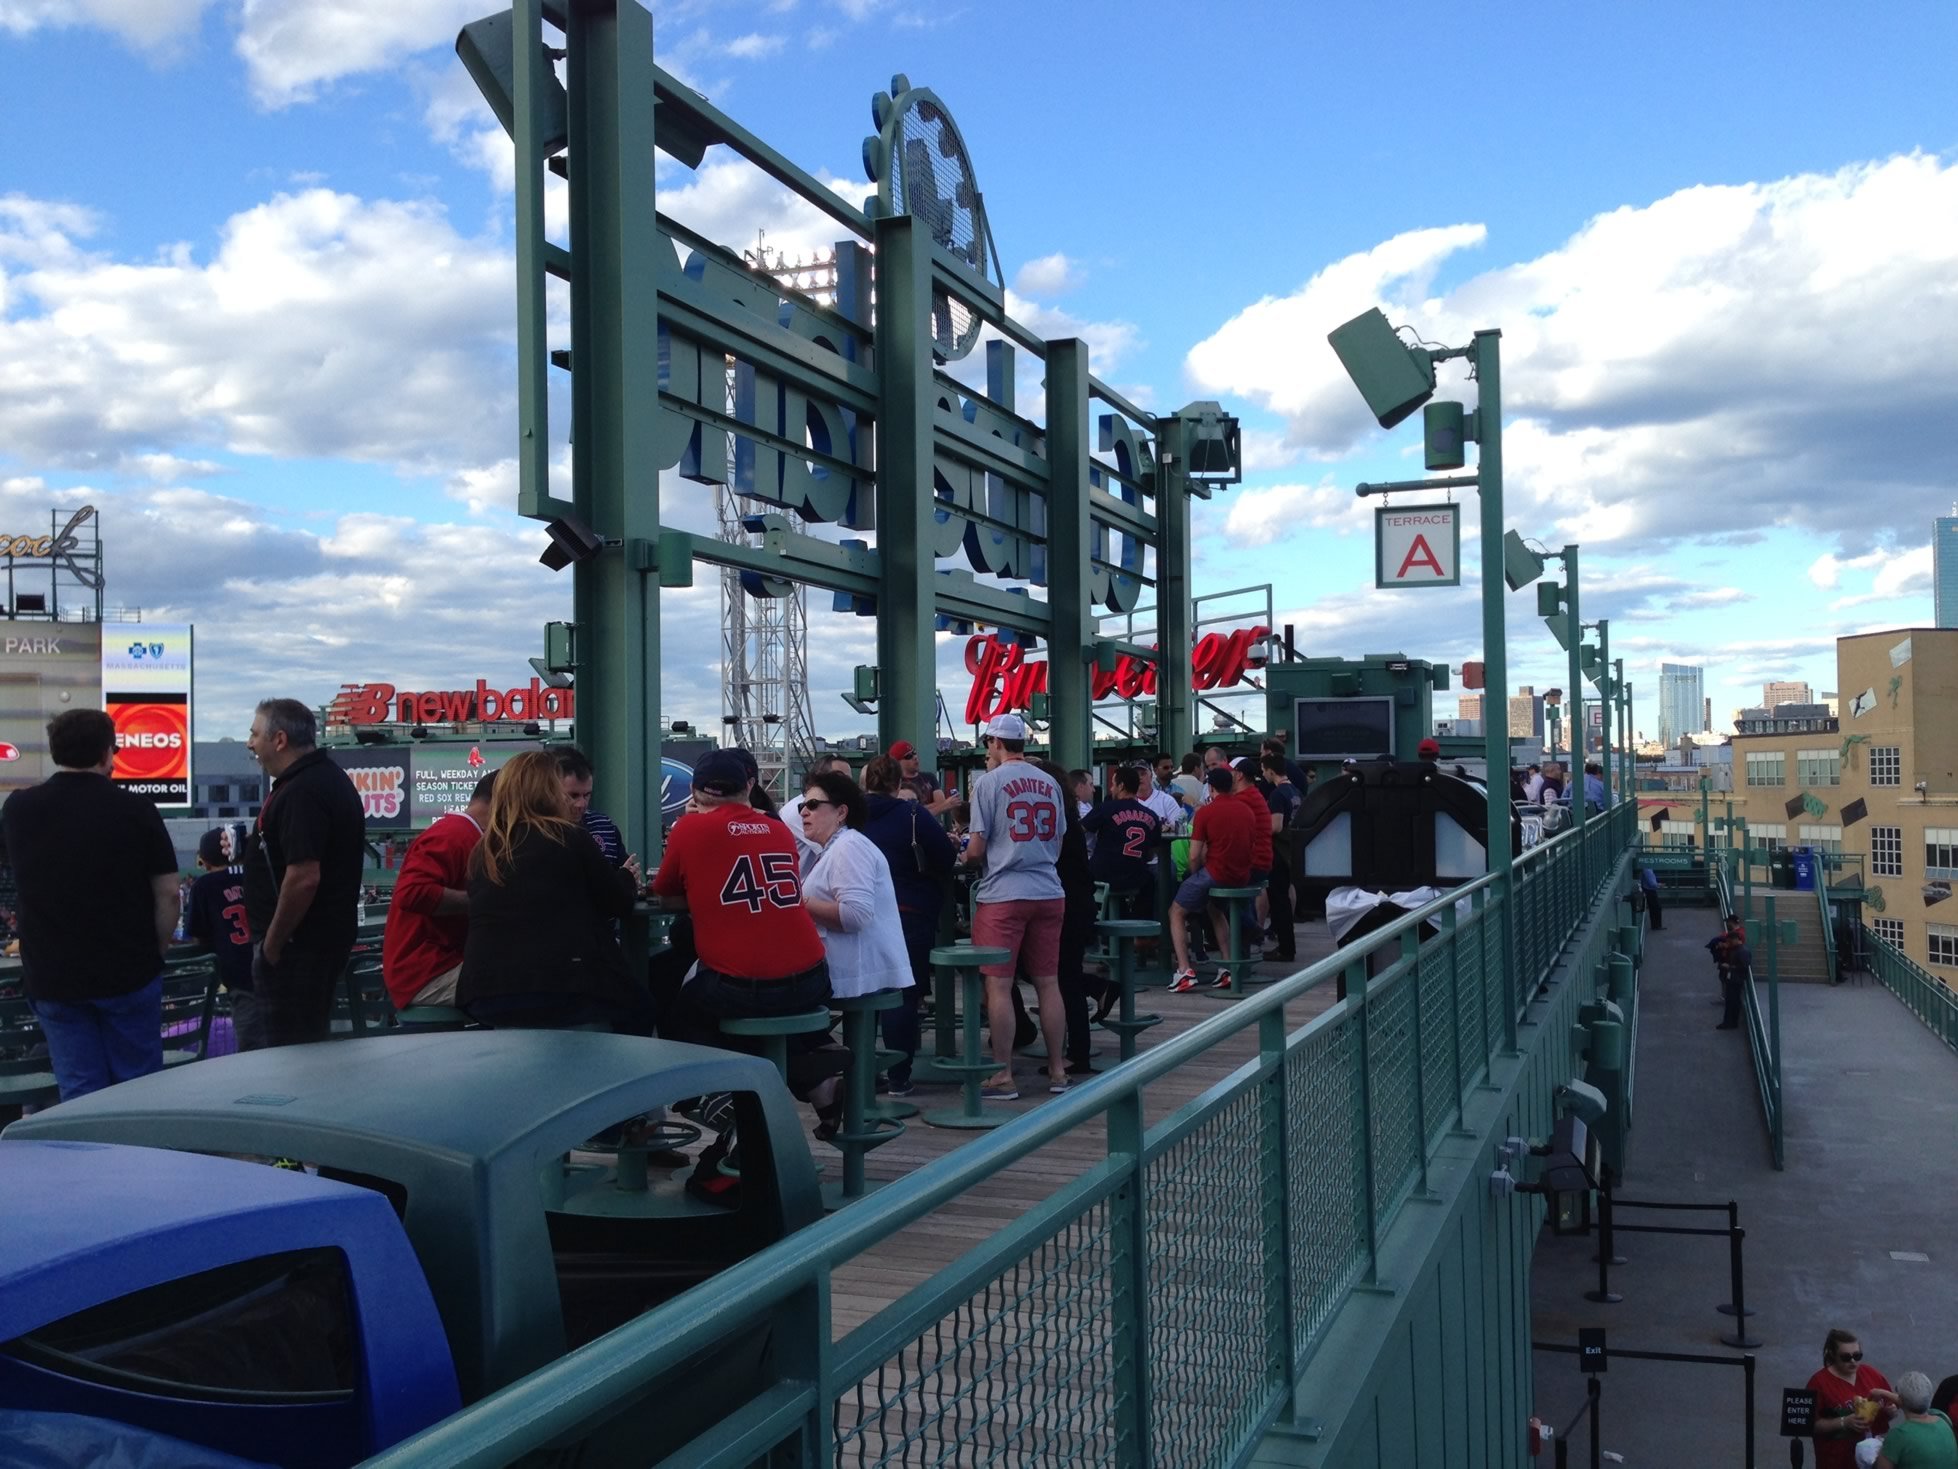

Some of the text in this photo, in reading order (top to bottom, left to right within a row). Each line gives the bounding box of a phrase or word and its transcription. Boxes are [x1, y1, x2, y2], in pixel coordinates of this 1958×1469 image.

[1385, 514, 1451, 527] TERRACE
[1396, 533, 1445, 578] A
[5, 637, 61, 654] PARK
[396, 690, 475, 724] new
[115, 732, 182, 748] ENEOS
[415, 771, 438, 780] FULL,
[441, 769, 478, 779] WEEKDAY
[128, 784, 168, 794] MOTOR
[169, 784, 188, 793] OIL
[416, 781, 448, 791] SEASON
[419, 793, 434, 803] RED
[437, 793, 452, 803] SOX
[1006, 801, 1057, 842] 33
[1122, 826, 1146, 858] 2
[719, 852, 802, 914] 45
[222, 904, 250, 945] 3
[1585, 1346, 1602, 1354] Exit
[1786, 1397, 1813, 1405] PLEASE
[1787, 1406, 1810, 1414] ENTER
[1788, 1417, 1807, 1425] HERE
